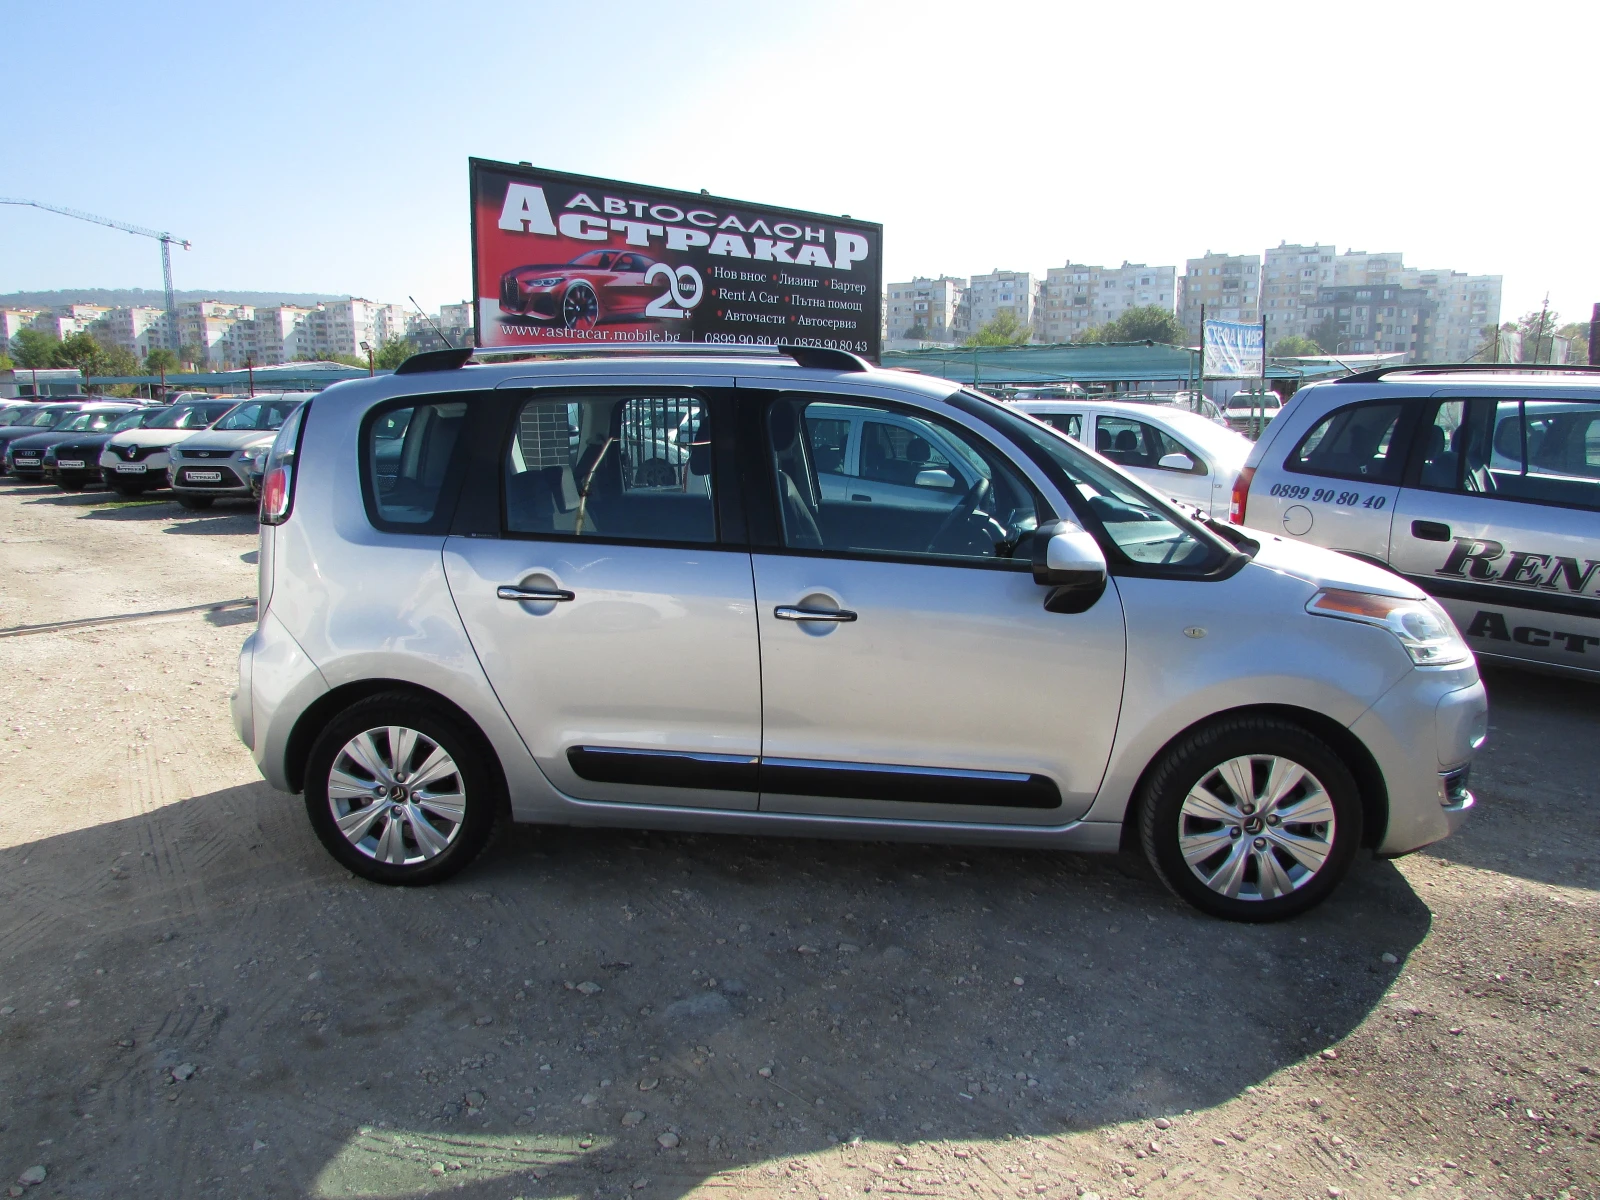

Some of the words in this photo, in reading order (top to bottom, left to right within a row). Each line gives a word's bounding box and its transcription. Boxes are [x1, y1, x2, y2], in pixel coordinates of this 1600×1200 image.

[498, 182, 869, 271] АСТРАКАР
[564, 192, 825, 243] АВТОСАЛОН
[714, 266, 738, 280] Нов
[740, 270, 767, 283] внос
[779, 273, 820, 288] Лизинг
[830, 278, 867, 295] Бартер
[718, 288, 746, 301] Rent
[748, 290, 758, 302] A
[759, 291, 780, 304] Car
[791, 294, 826, 308] Пътна
[828, 299, 863, 312] помощ
[724, 309, 786, 324] Авточасти
[797, 314, 857, 330] Автосервиз
[501, 323, 681, 344] www.astracar.mobile.bg
[704, 332, 736, 343] 0899
[738, 333, 754, 344] 90
[756, 335, 772, 345] 80
[773, 336, 788, 346] 40
[794, 337, 822, 348] 0878
[823, 339, 838, 350] 90
[839, 340, 853, 351] 80
[854, 341, 868, 352] 43
[1269, 483, 1310, 500] 0899
[1311, 488, 1335, 503] 90
[1335, 491, 1360, 507] 80
[1362, 494, 1386, 510] 40
[1434, 536, 1600, 597] REN
